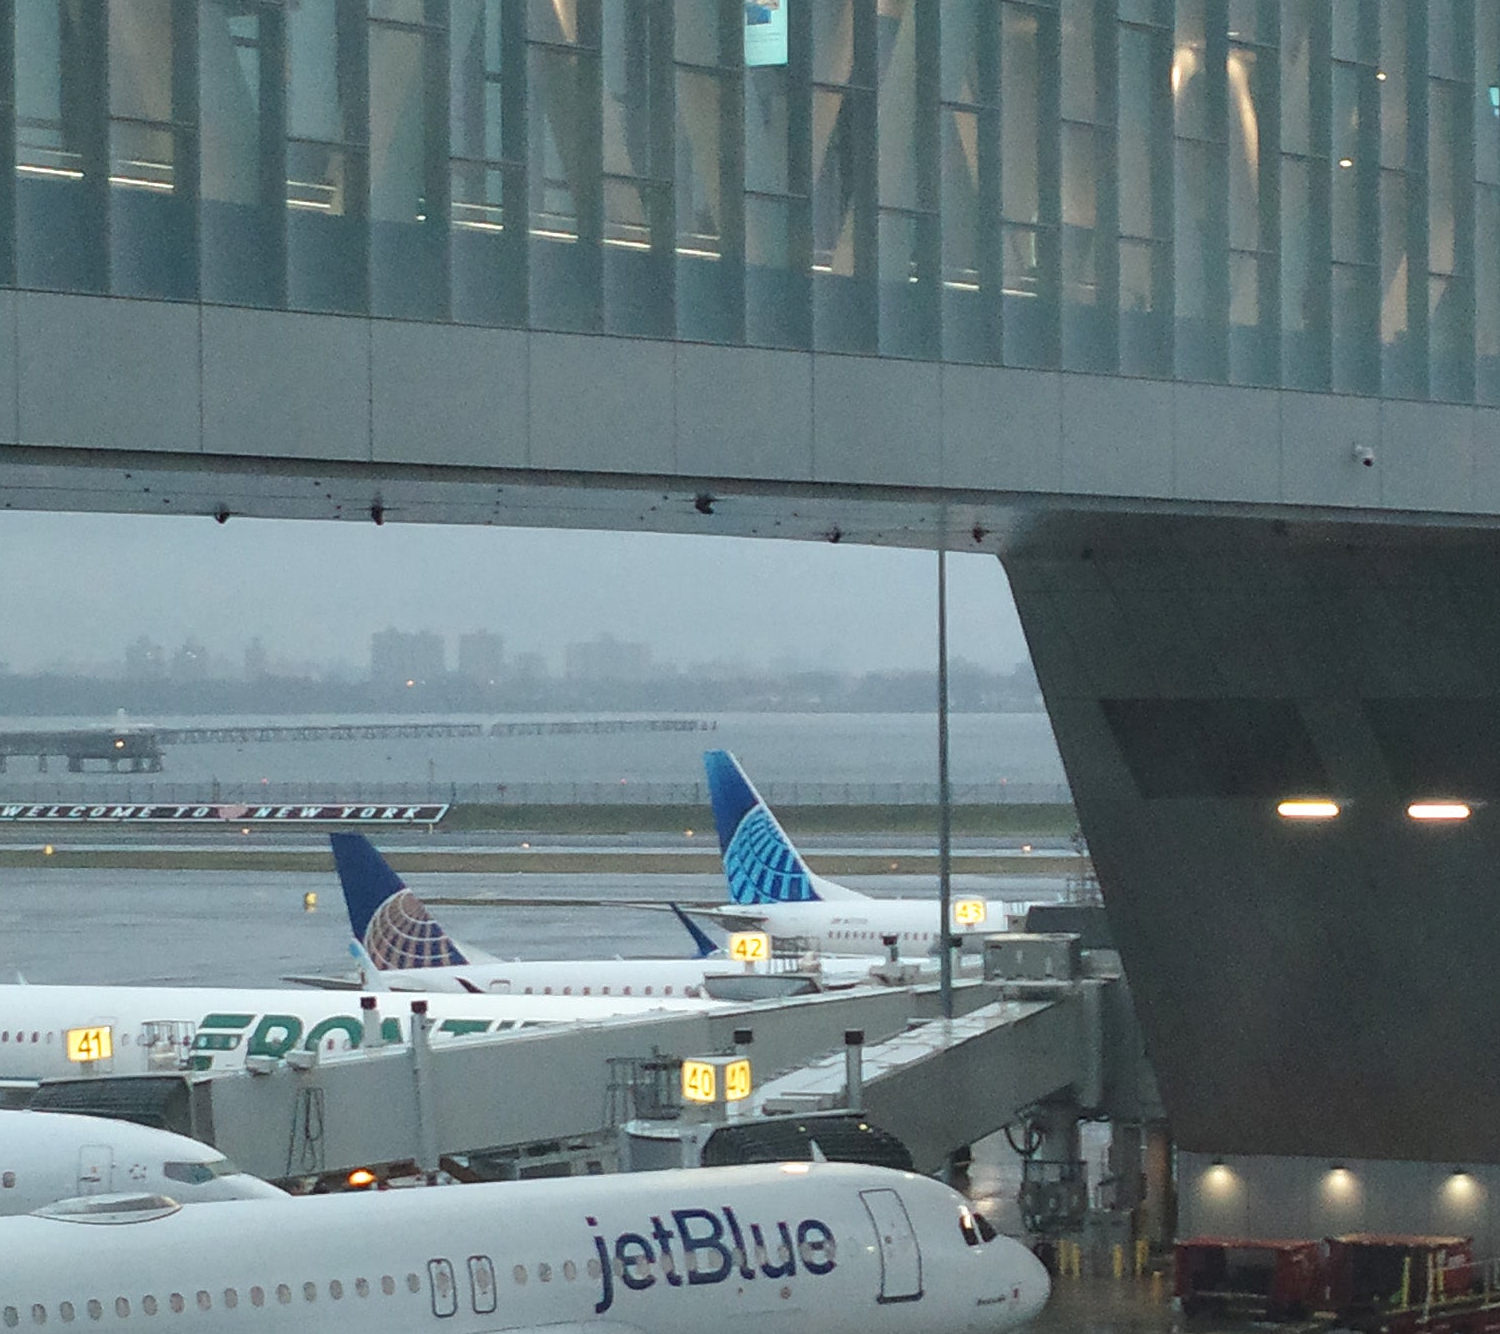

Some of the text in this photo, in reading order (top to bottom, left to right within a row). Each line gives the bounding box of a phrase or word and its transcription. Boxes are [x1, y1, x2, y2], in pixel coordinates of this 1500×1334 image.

[0, 804, 421, 819] WELCOME TO NEW YORK
[957, 903, 981, 920] 43
[736, 938, 762, 957] 42
[78, 1031, 102, 1058] 41
[688, 1067, 711, 1096] 40
[727, 1065, 747, 1093] 40
[585, 1206, 837, 1314] jetBlue
